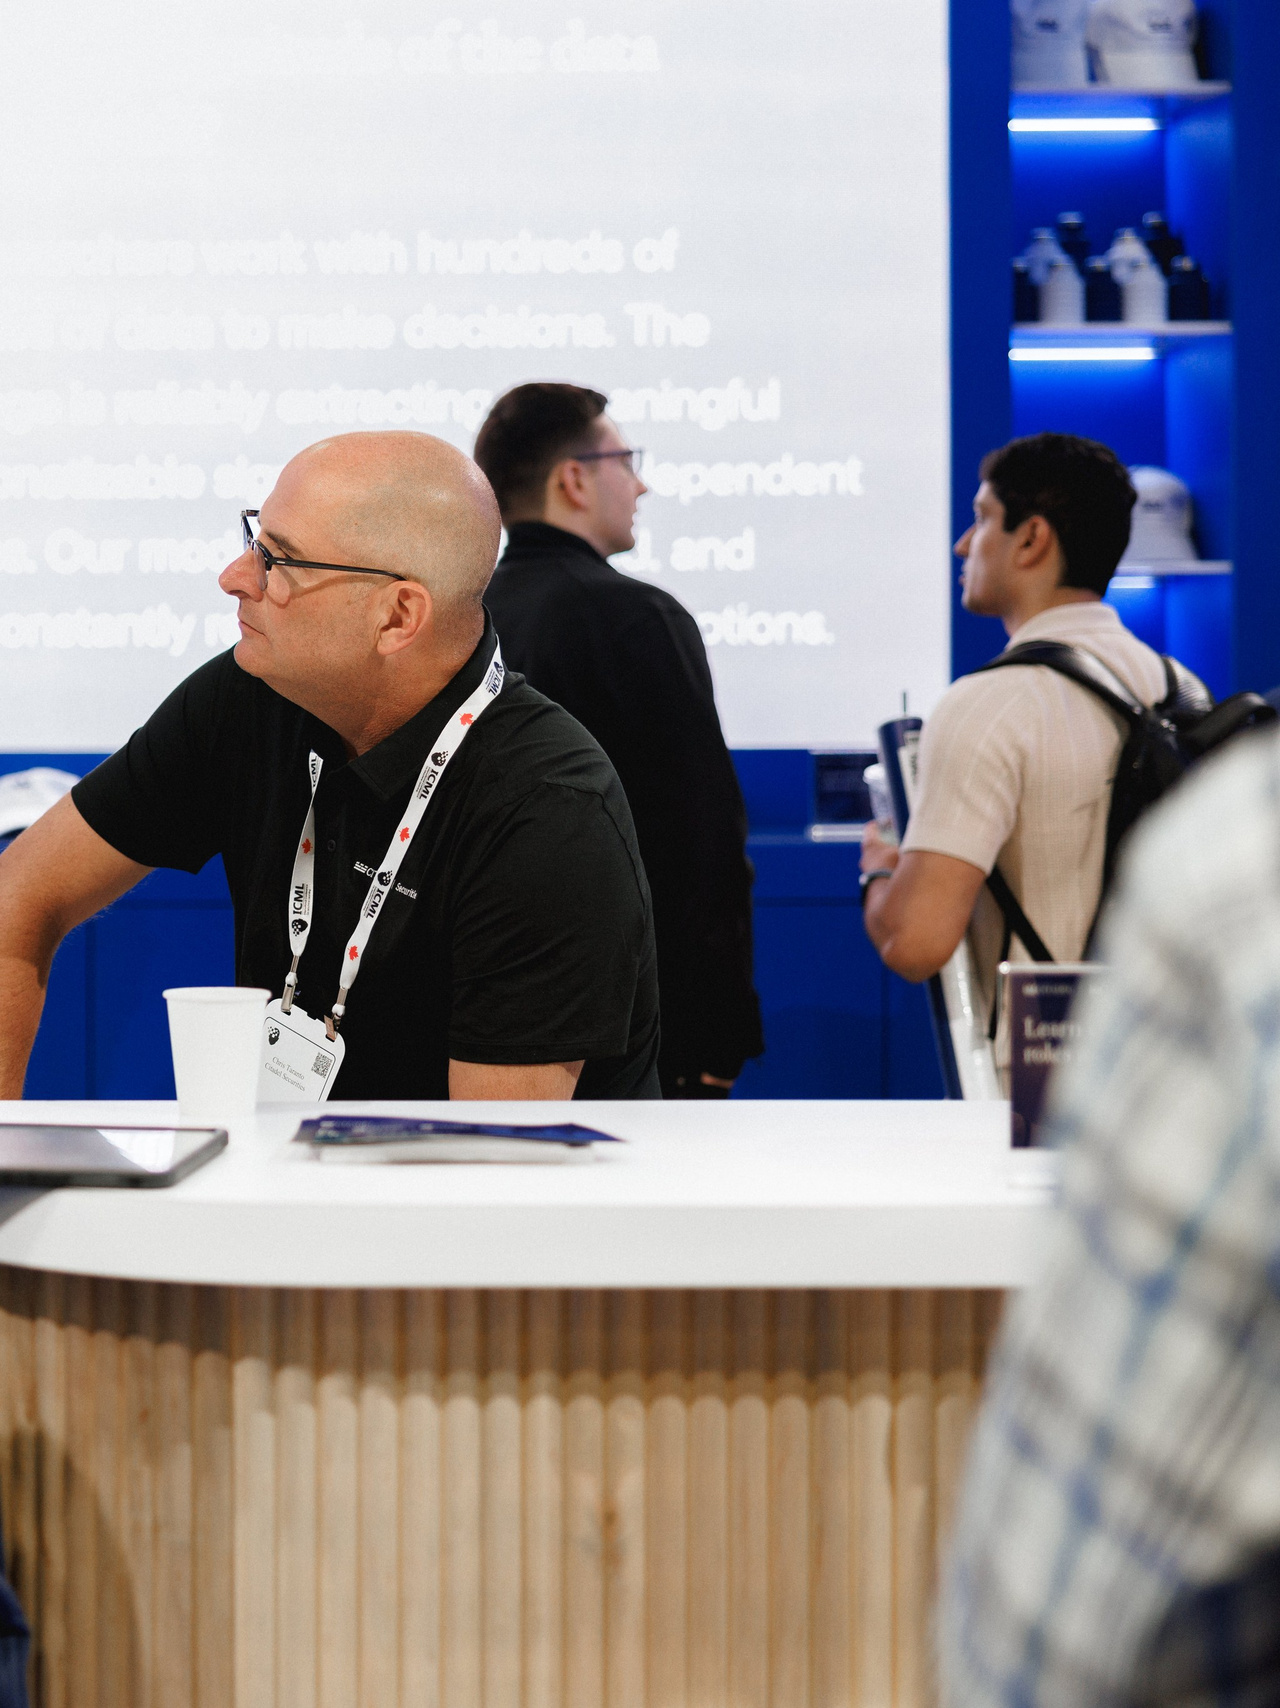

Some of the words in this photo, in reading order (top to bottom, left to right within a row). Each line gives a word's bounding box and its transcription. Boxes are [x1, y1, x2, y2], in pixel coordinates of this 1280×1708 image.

[398, 18, 458, 76] of
[459, 18, 543, 75] the
[549, 17, 660, 74] data
[313, 230, 407, 274] with
[417, 229, 624, 275] hundreds
[633, 228, 679, 273] of
[222, 308, 271, 350] to
[277, 306, 395, 350] make
[403, 306, 616, 350] decisions.
[623, 300, 711, 347] The
[274, 381, 491, 432] extracting
[610, 378, 780, 431] aningful
[643, 453, 863, 503] ependent
[44, 528, 132, 575] Our
[671, 528, 755, 571] and
[420, 768, 439, 800] ICML
[292, 883, 305, 915] ICML
[365, 888, 385, 919] ICML
[264, 1062, 283, 1077] Citadel
[281, 1073, 306, 1092] Securities
[272, 1056, 286, 1069] Chris
